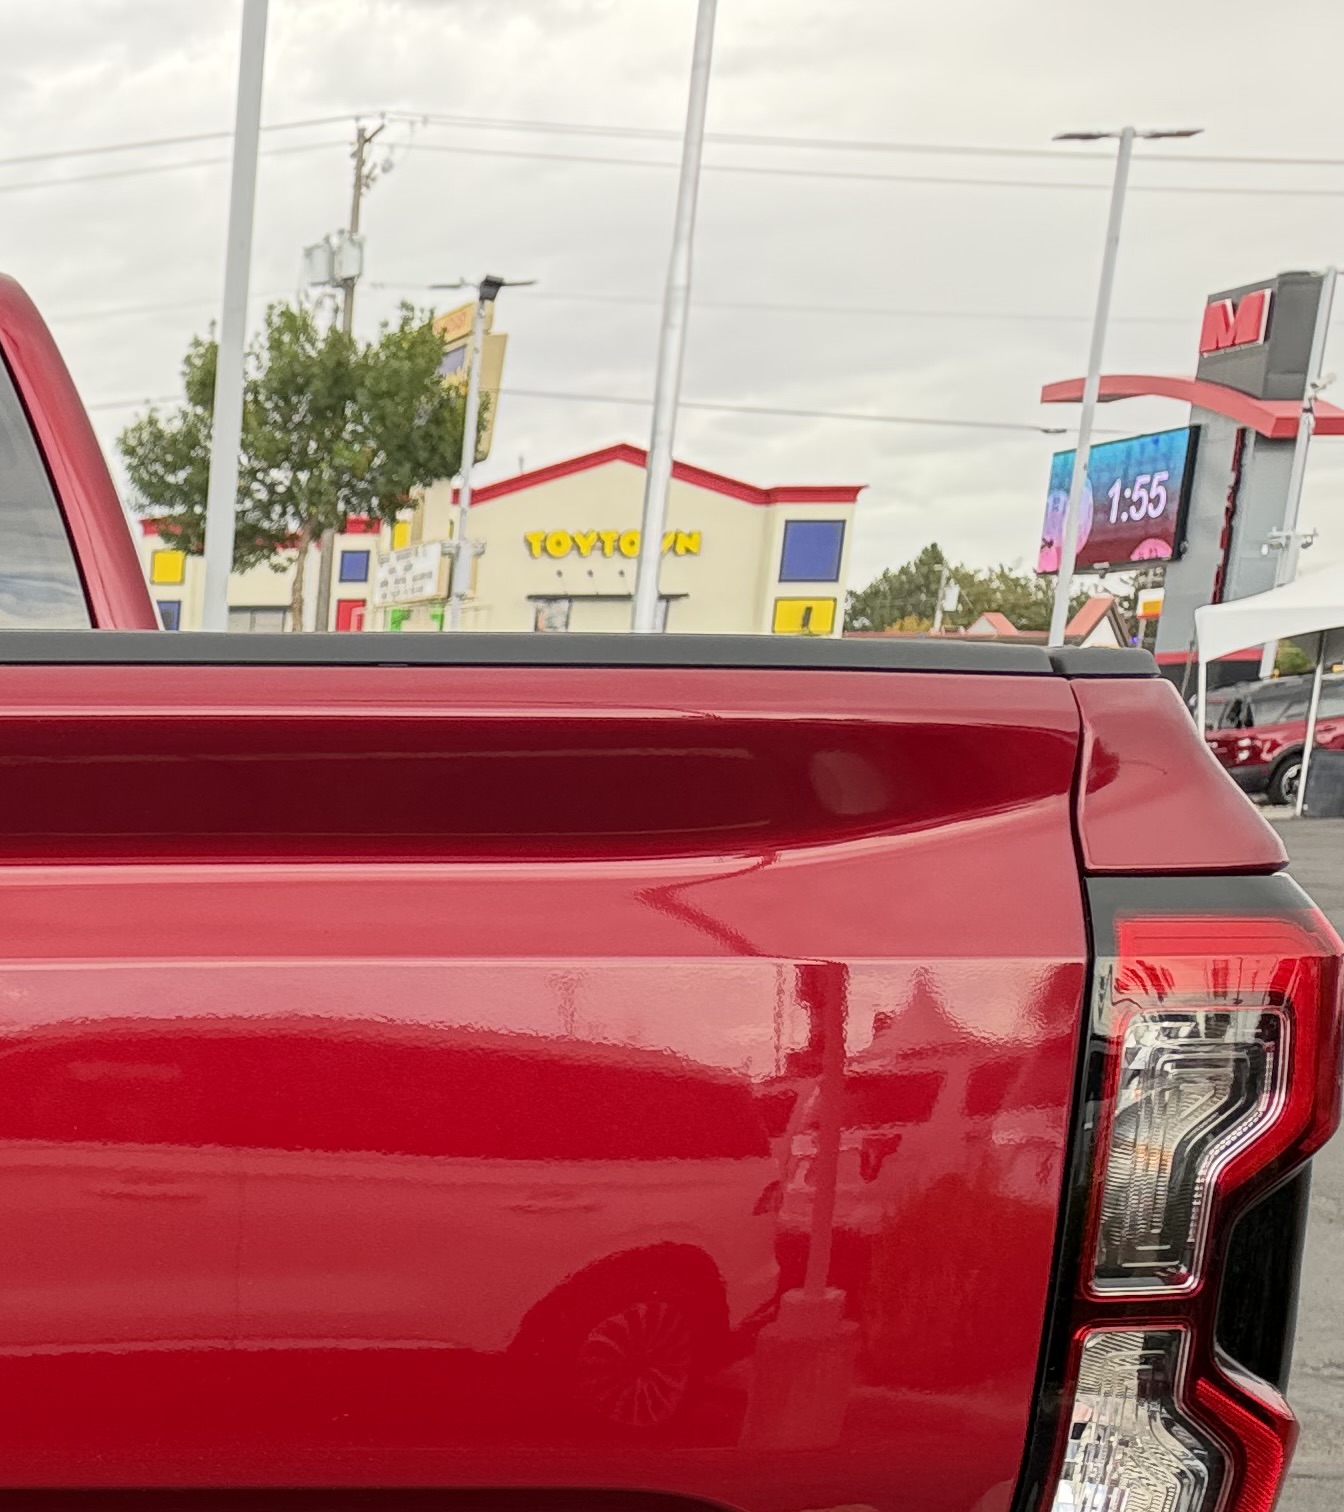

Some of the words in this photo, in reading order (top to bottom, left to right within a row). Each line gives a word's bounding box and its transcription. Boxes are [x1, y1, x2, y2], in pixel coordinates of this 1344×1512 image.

[1199, 288, 1272, 353] M
[1108, 471, 1169, 523] 1:55
[524, 529, 702, 559] TOYTON
